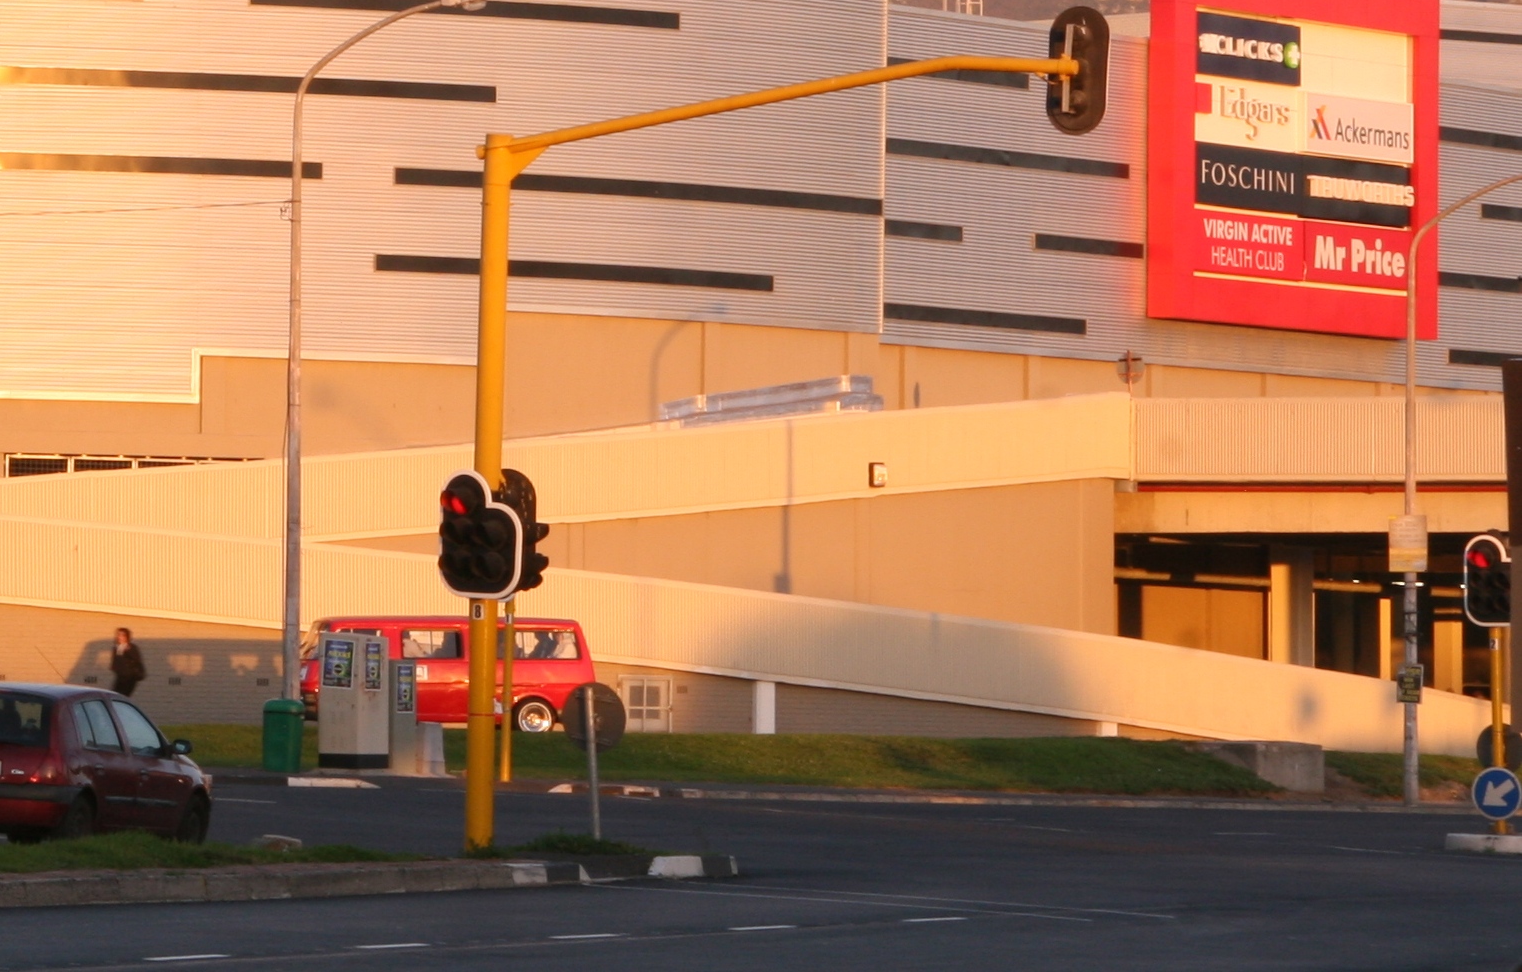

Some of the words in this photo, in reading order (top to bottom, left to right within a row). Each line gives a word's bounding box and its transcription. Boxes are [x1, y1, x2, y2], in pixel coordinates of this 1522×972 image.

[1218, 35, 1284, 63] CLICKS
[1219, 84, 1291, 141] Edgars
[1334, 117, 1410, 150] Ackermans
[1201, 159, 1295, 195] FOSCHINI
[1203, 218, 1249, 241] VIRGIN
[1251, 223, 1293, 246] ACTIVE
[1211, 245, 1253, 269] HEALTH
[1255, 249, 1285, 272] CLUB
[1314, 234, 1347, 271] Mr
[1350, 237, 1406, 278] Price
[474, 604, 482, 619] 8
